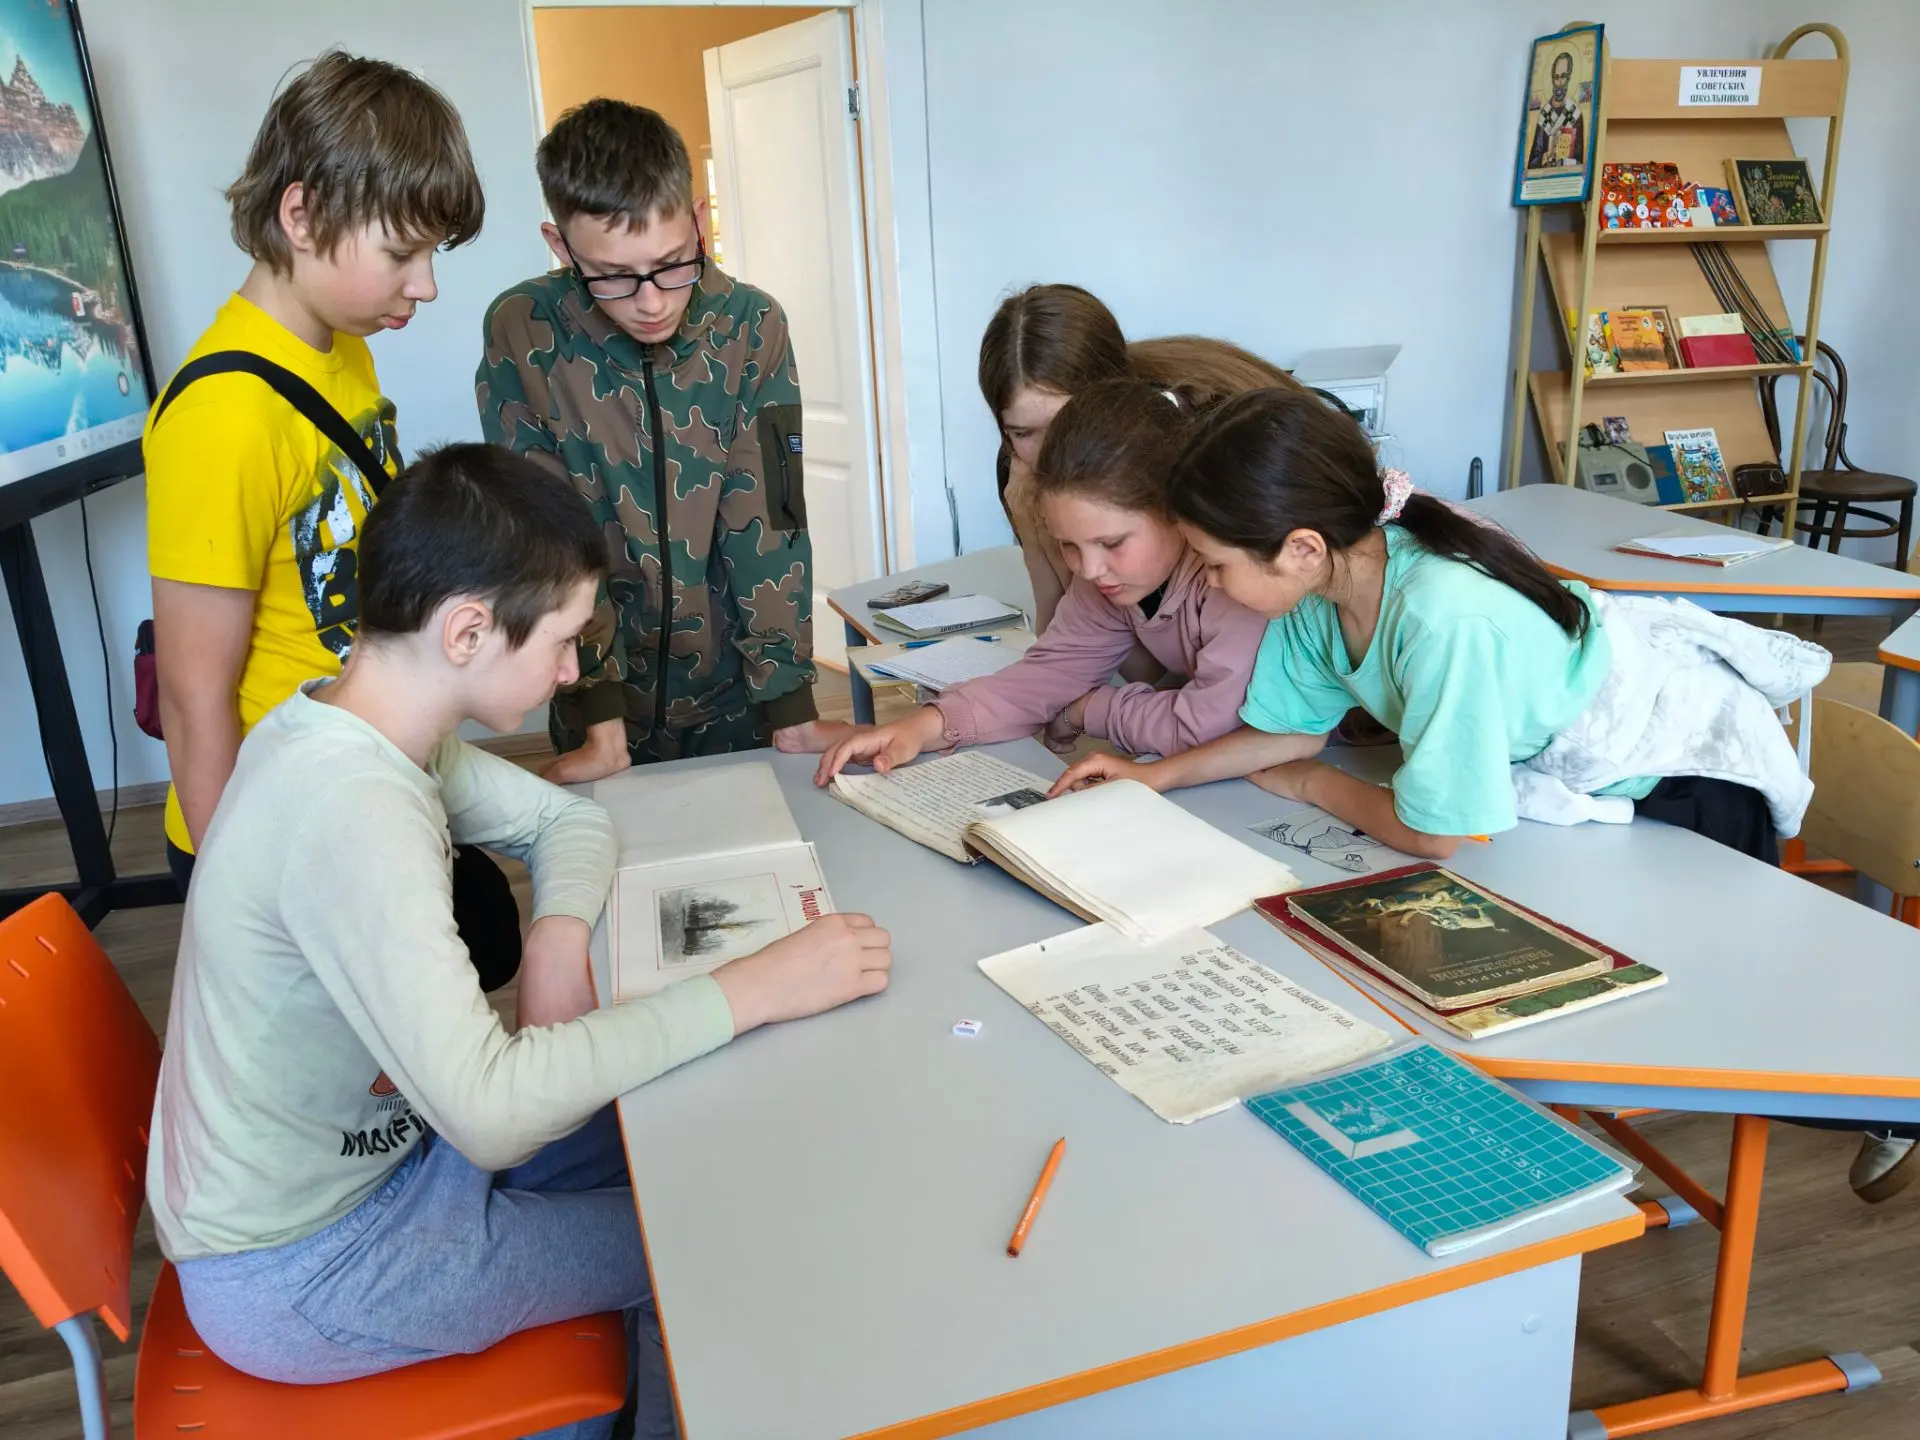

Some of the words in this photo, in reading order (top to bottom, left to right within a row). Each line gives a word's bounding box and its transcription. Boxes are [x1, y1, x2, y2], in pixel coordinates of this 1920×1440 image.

[1697, 69, 1747, 78] УВЛЕЧЕНИЯ
[1695, 82, 1745, 90] СОВЕТСКИХ
[1690, 94, 1749, 103] ШКОЛЬНИКОВ
[1172, 969, 1193, 981] ЧТО
[1413, 1056, 1469, 1092] ЯЗЫК
[1380, 1065, 1547, 1180] ИНОСТРАННЫЙ
